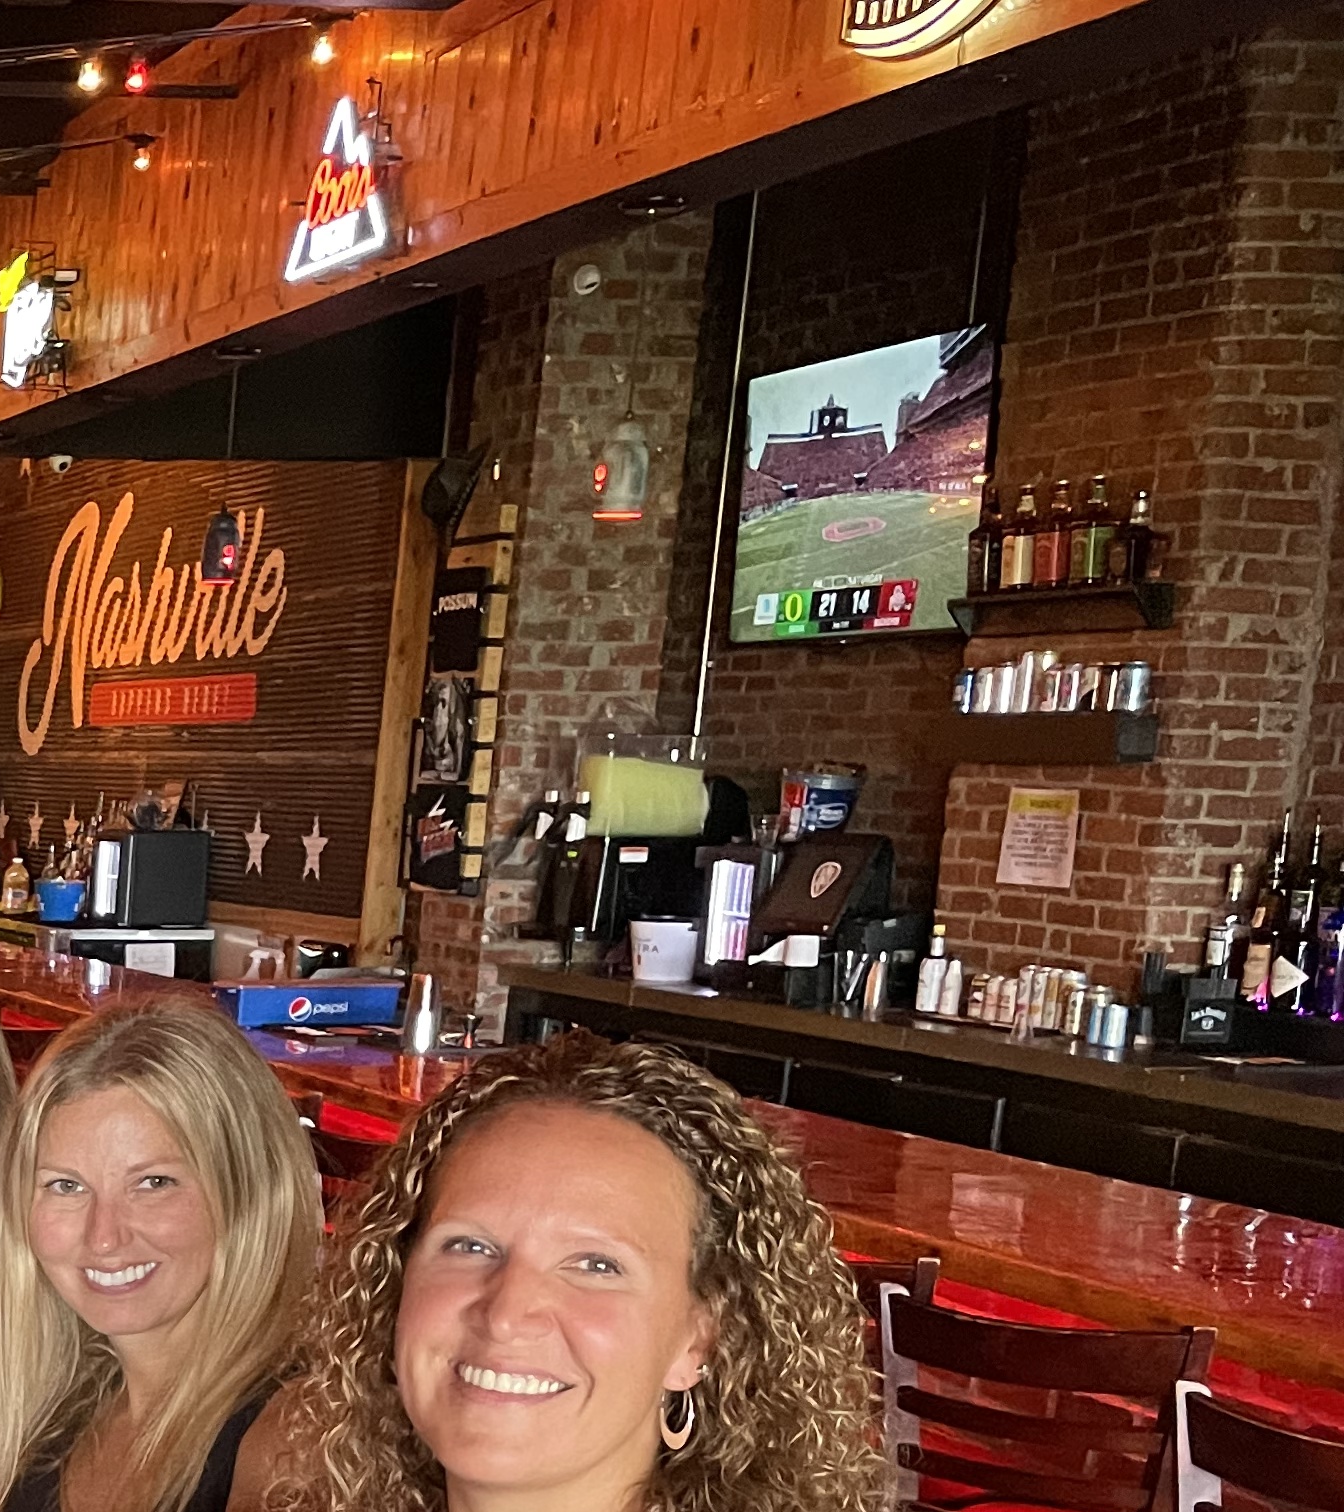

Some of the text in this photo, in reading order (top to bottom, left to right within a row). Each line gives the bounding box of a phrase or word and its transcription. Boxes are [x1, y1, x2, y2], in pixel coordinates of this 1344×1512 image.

[306, 158, 376, 229] Coors
[818, 592, 837, 617] 21
[853, 589, 870, 614] 14
